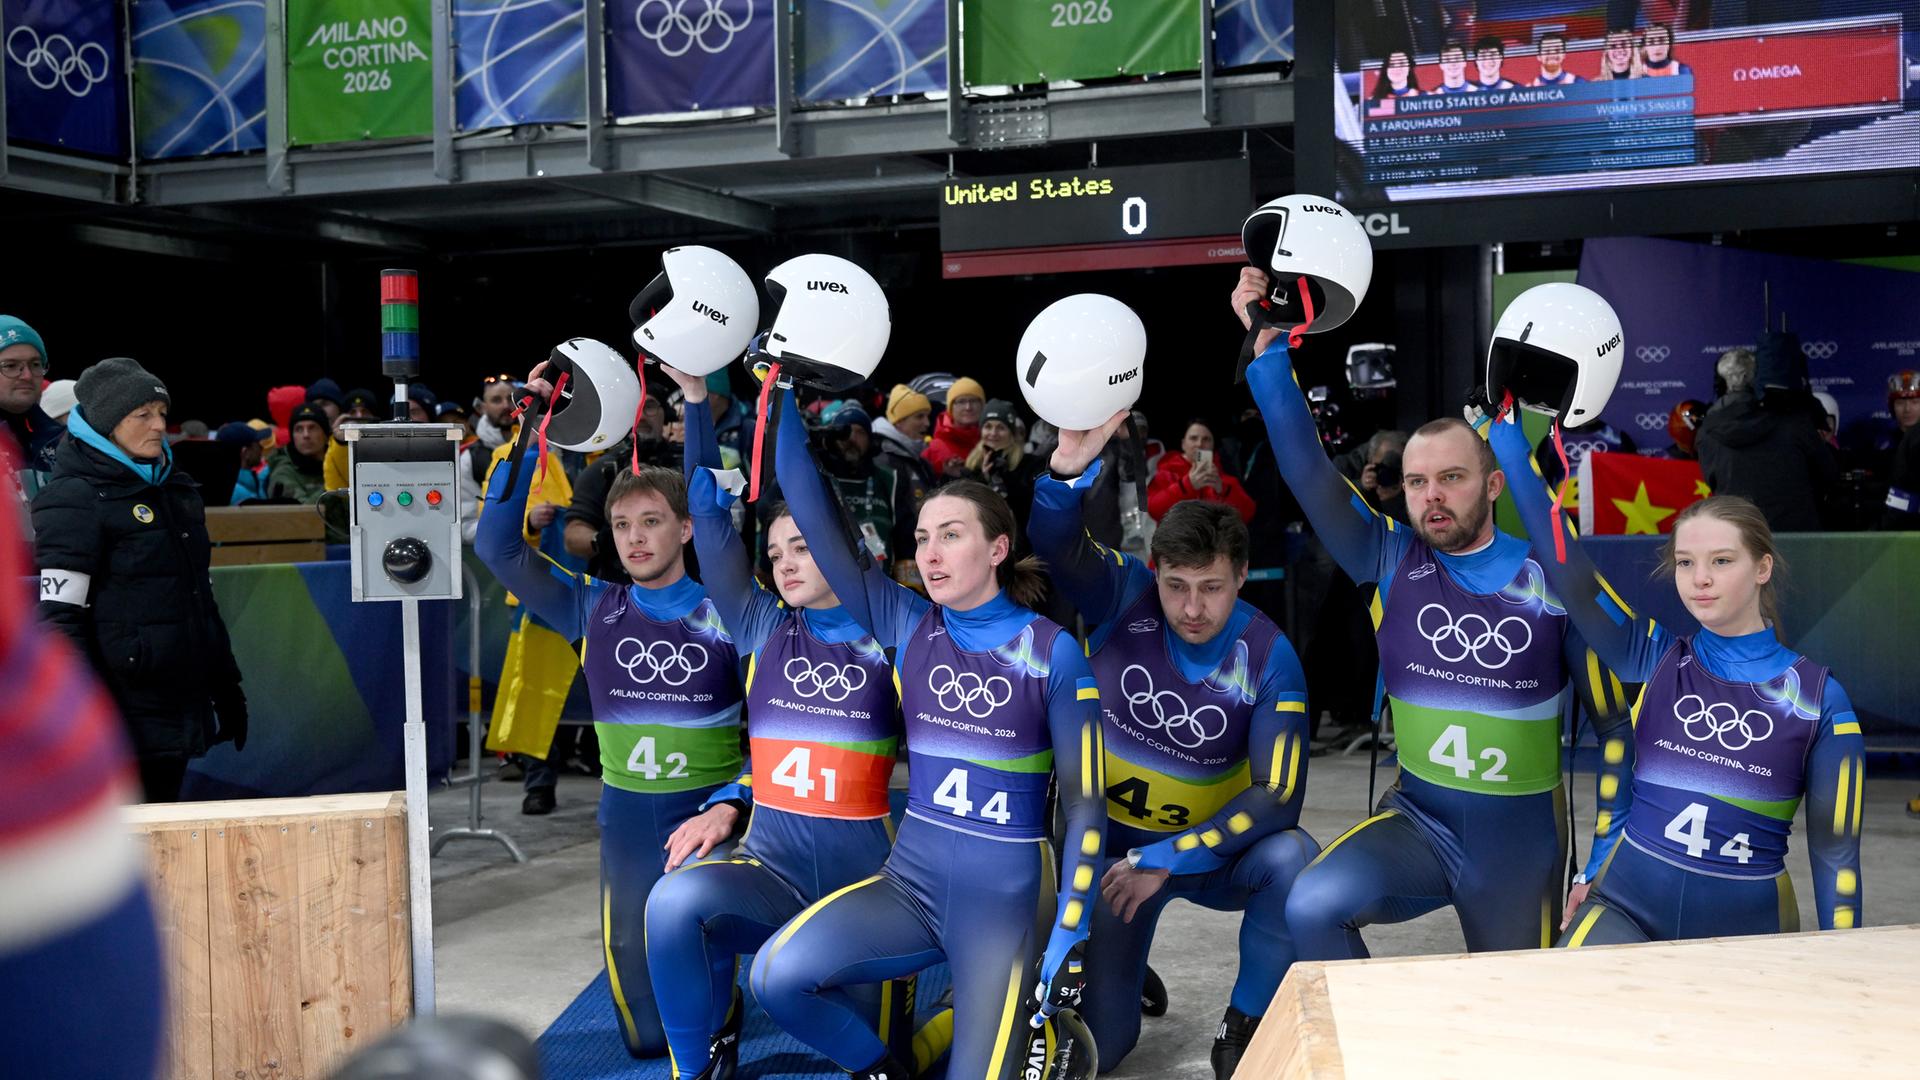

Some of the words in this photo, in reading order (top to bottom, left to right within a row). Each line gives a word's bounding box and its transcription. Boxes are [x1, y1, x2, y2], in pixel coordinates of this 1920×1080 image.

[1051, 1, 1113, 27] 2026
[307, 16, 408, 47] MILANO
[323, 40, 428, 70] CORTINA
[342, 70, 392, 94] 2026
[1749, 64, 1801, 81] OMEGA
[1400, 99, 1443, 113] UNITED
[1447, 95, 1488, 109] STATES
[1508, 89, 1565, 104] AMERICA
[1382, 117, 1462, 132] FARQUHARSON
[945, 181, 1018, 206] United
[1030, 177, 1114, 200] States
[1122, 196, 1147, 235] 0
[1303, 204, 1343, 217] uvex
[1217, 247, 1247, 257] OMEGA
[807, 280, 849, 295] uvex
[692, 299, 730, 327] uvex
[1596, 332, 1621, 358] uvex
[1109, 366, 1139, 386] uvex
[1406, 662, 1454, 681] MILANO
[1456, 673, 1512, 689] CORTINA
[1515, 679, 1539, 689] 2026
[609, 688, 646, 699] MILANO
[647, 692, 691, 702] CORTINA
[693, 694, 713, 702] 2026
[768, 698, 806, 712] MILANO
[807, 706, 848, 718] CORTINA
[850, 711, 871, 720] 2026
[916, 712, 951, 727] MILANO
[952, 721, 992, 736] CORTINA
[994, 729, 1016, 738] 2026
[1103, 709, 1145, 741] MILANO
[1146, 738, 1200, 764] CORTINA
[1202, 757, 1227, 765] 2026
[1654, 739, 1696, 757] MILANO
[1697, 751, 1746, 771] CORTINA
[1748, 764, 1772, 777] 2026
